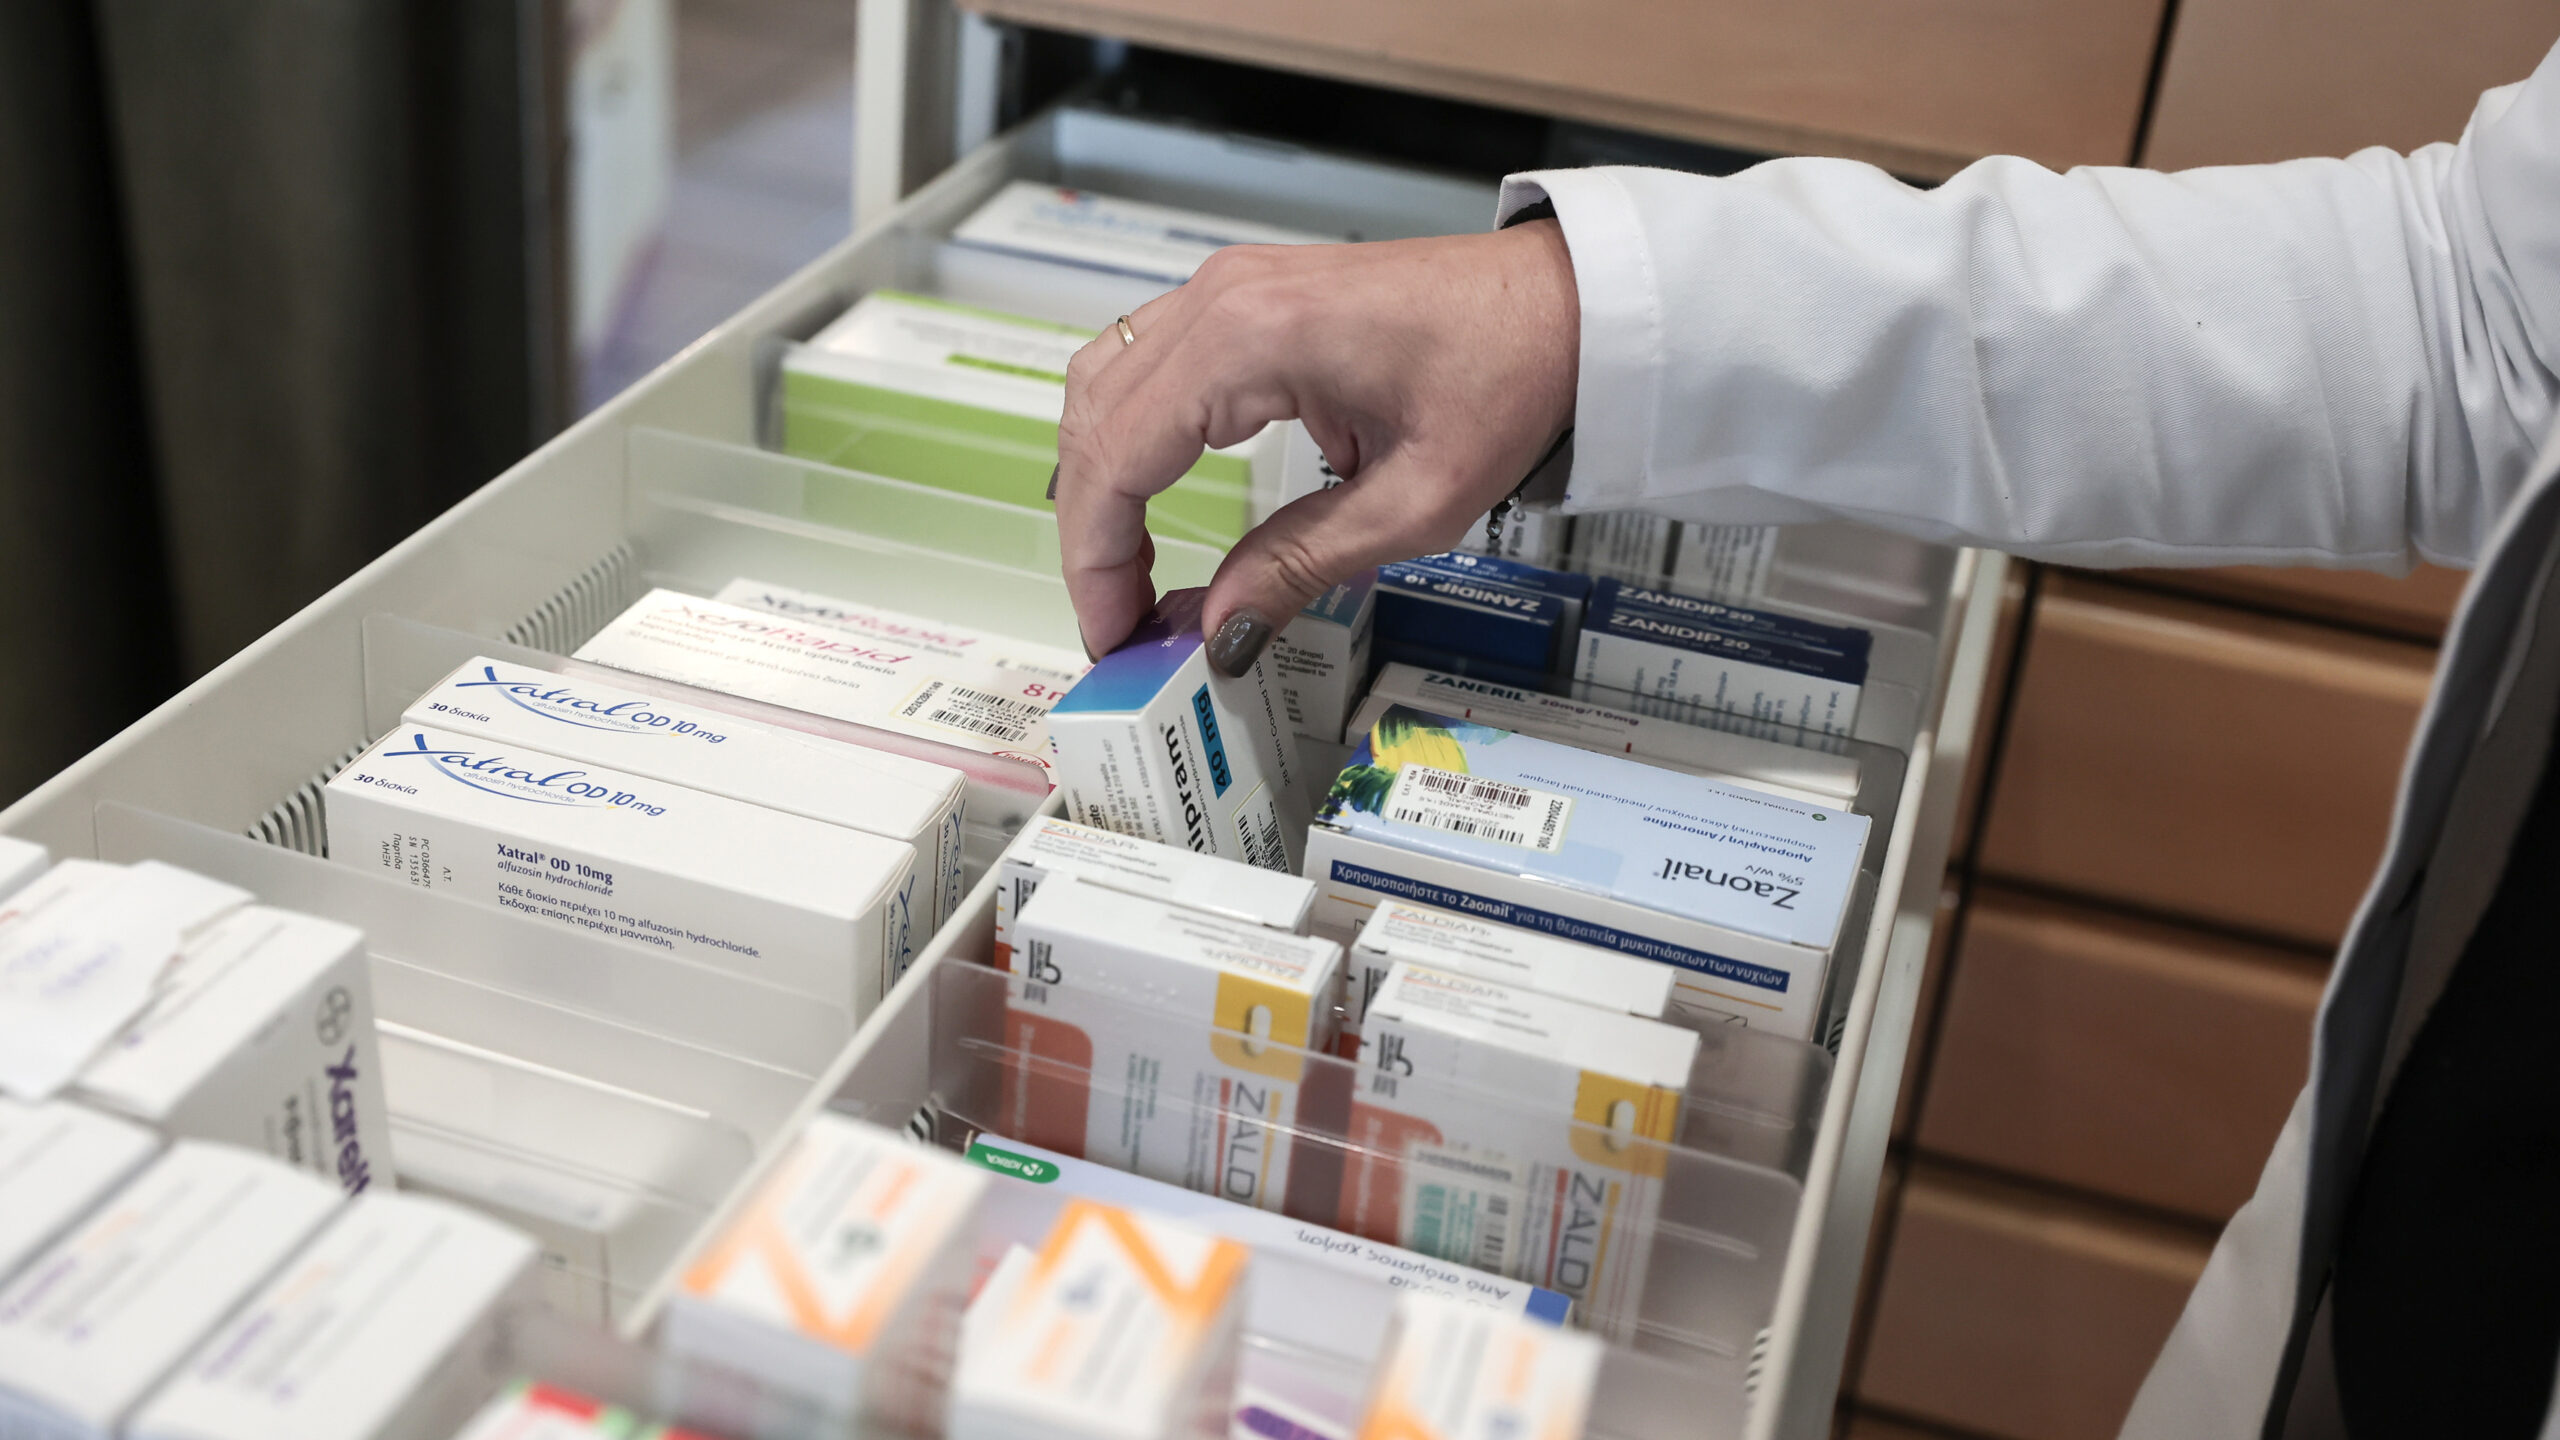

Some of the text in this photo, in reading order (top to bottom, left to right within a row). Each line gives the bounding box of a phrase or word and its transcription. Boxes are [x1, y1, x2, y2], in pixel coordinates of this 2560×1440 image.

[1404, 573, 1429, 586] 10
[1433, 582, 1542, 612] ZANIDIP
[1617, 586, 1727, 615] ZANIDIP
[1726, 609, 1756, 623] 20
[1609, 613, 1723, 643] ZANIDIP
[1722, 639, 1751, 651] 20
[1292, 656, 1335, 671] Citalopram
[427, 701, 491, 724] 30 δισκία
[456, 666, 650, 718] Xatral
[630, 711, 672, 730] OD
[670, 719, 695, 735] 10
[694, 730, 728, 745] mg
[1423, 672, 1526, 702] ZANERIL
[1539, 698, 1640, 727] 20mg/10mg
[1253, 659, 1291, 787] 28 Film Coated Tab
[1198, 690, 1228, 788] 40 mg
[1003, 752, 1043, 768] Takeda
[352, 772, 419, 797] 30 δισκία
[382, 733, 668, 818] Xatral OD 10 mg
[1516, 771, 1558, 789] lacquer
[1561, 780, 1585, 796] nail
[1585, 788, 1647, 811] medicated
[1198, 792, 1217, 854] Citalopram
[1642, 814, 1718, 841] Amorolfine
[381, 840, 392, 868] ΛΗΞΗ
[392, 833, 404, 871] Παρτίδα
[408, 836, 418, 848] SN
[420, 837, 430, 851] PC
[496, 859, 614, 898] alfuzosin hydrochloride
[549, 856, 571, 873] OD
[574, 863, 614, 887] 10mg
[1660, 857, 1801, 911] Zaonail
[1743, 863, 1806, 886] 5% w/v
[497, 881, 524, 897] Κάθε
[524, 888, 558, 906] δισκίο
[559, 898, 602, 918] περιέχει
[604, 908, 617, 921] 10
[617, 913, 636, 928] mg
[637, 918, 684, 938] alfuzosin
[540, 907, 576, 925] επίσης
[577, 917, 618, 935] περιέχει
[1336, 864, 1440, 902] Χρησιμοποιήστε
[1441, 892, 1457, 905] το
[1514, 909, 1536, 925] για
[1537, 915, 1552, 930] τη
[1555, 917, 1618, 946] θεραπεία
[1618, 935, 1709, 969] μυκητιάσεων
[1708, 957, 1736, 976] των
[1735, 964, 1785, 987] νυχιών
[1225, 1080, 1266, 1201] ZALD
[1366, 1249, 1460, 1286] στόματος
[1467, 1277, 1512, 1301] Από
